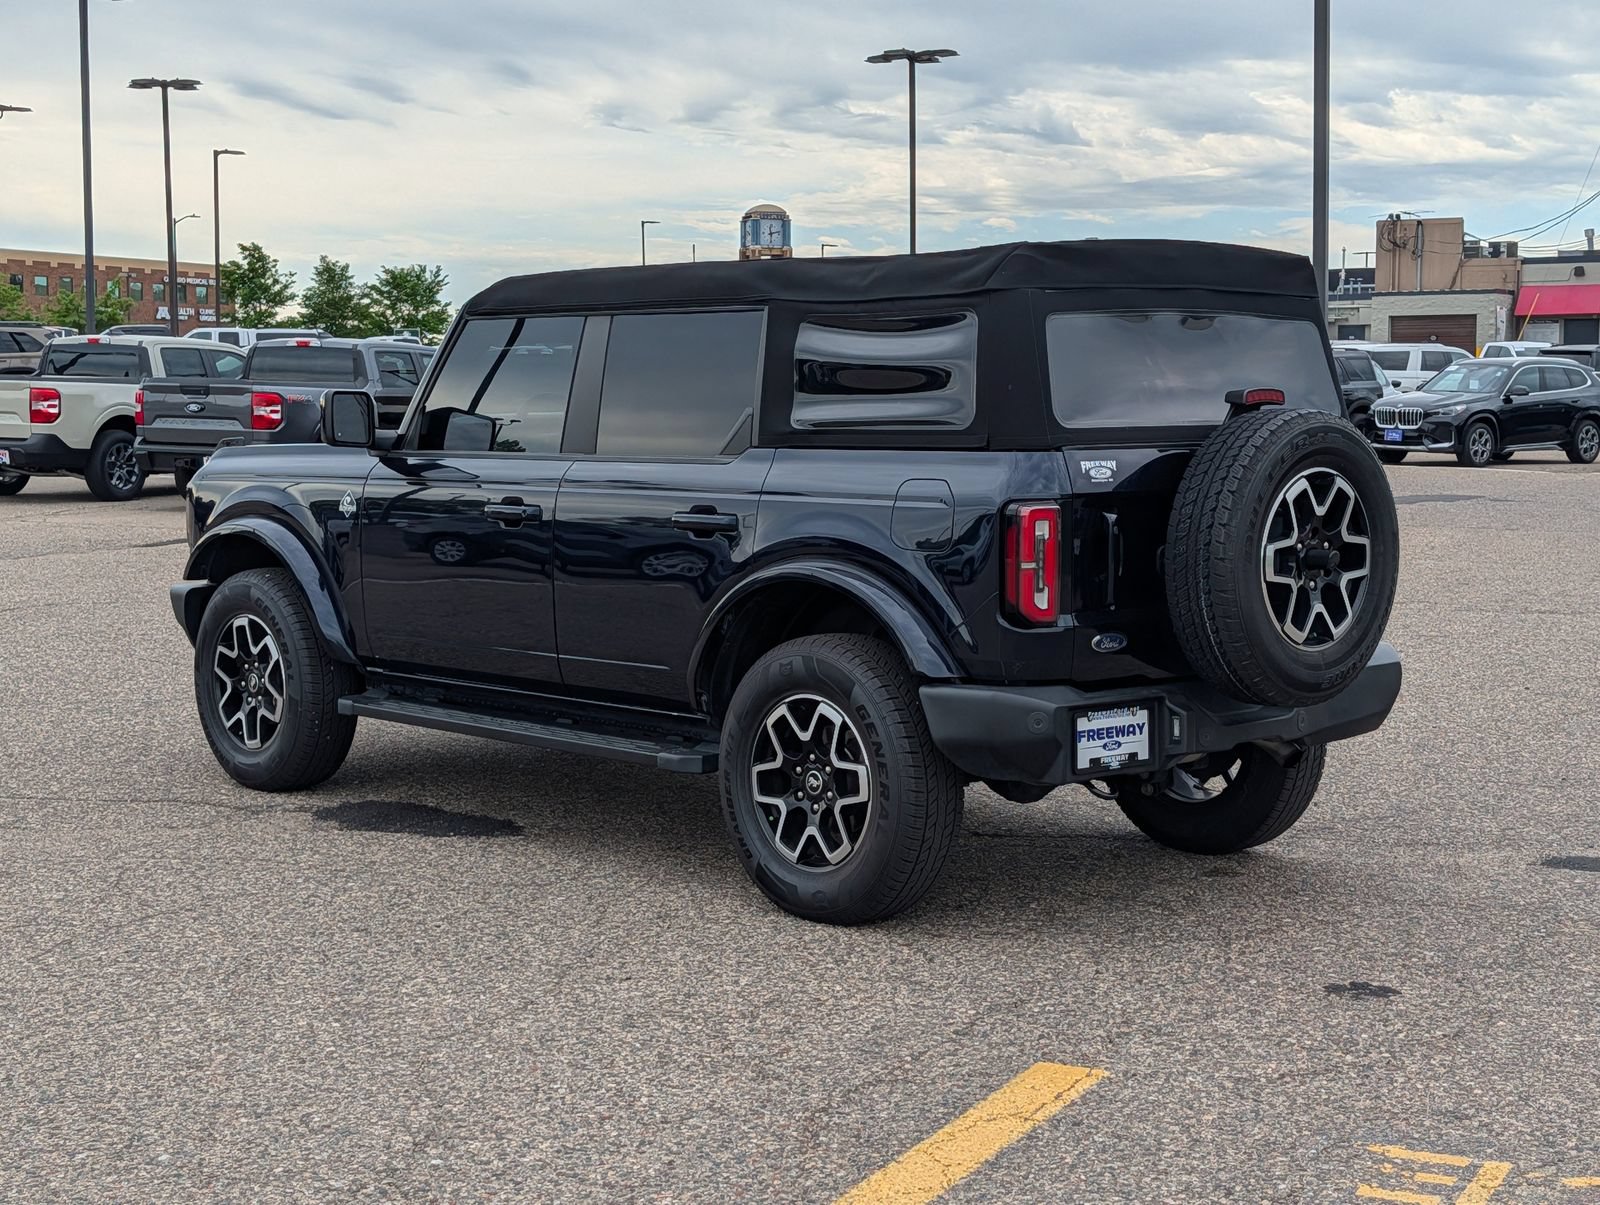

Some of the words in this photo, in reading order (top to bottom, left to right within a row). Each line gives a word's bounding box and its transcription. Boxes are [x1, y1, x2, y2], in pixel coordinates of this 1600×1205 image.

[1080, 460, 1117, 474] FREEWAY
[1077, 722, 1146, 744] FREEWAY
[1104, 741, 1120, 751] Ford
[1100, 754, 1129, 764] FREEWAY
